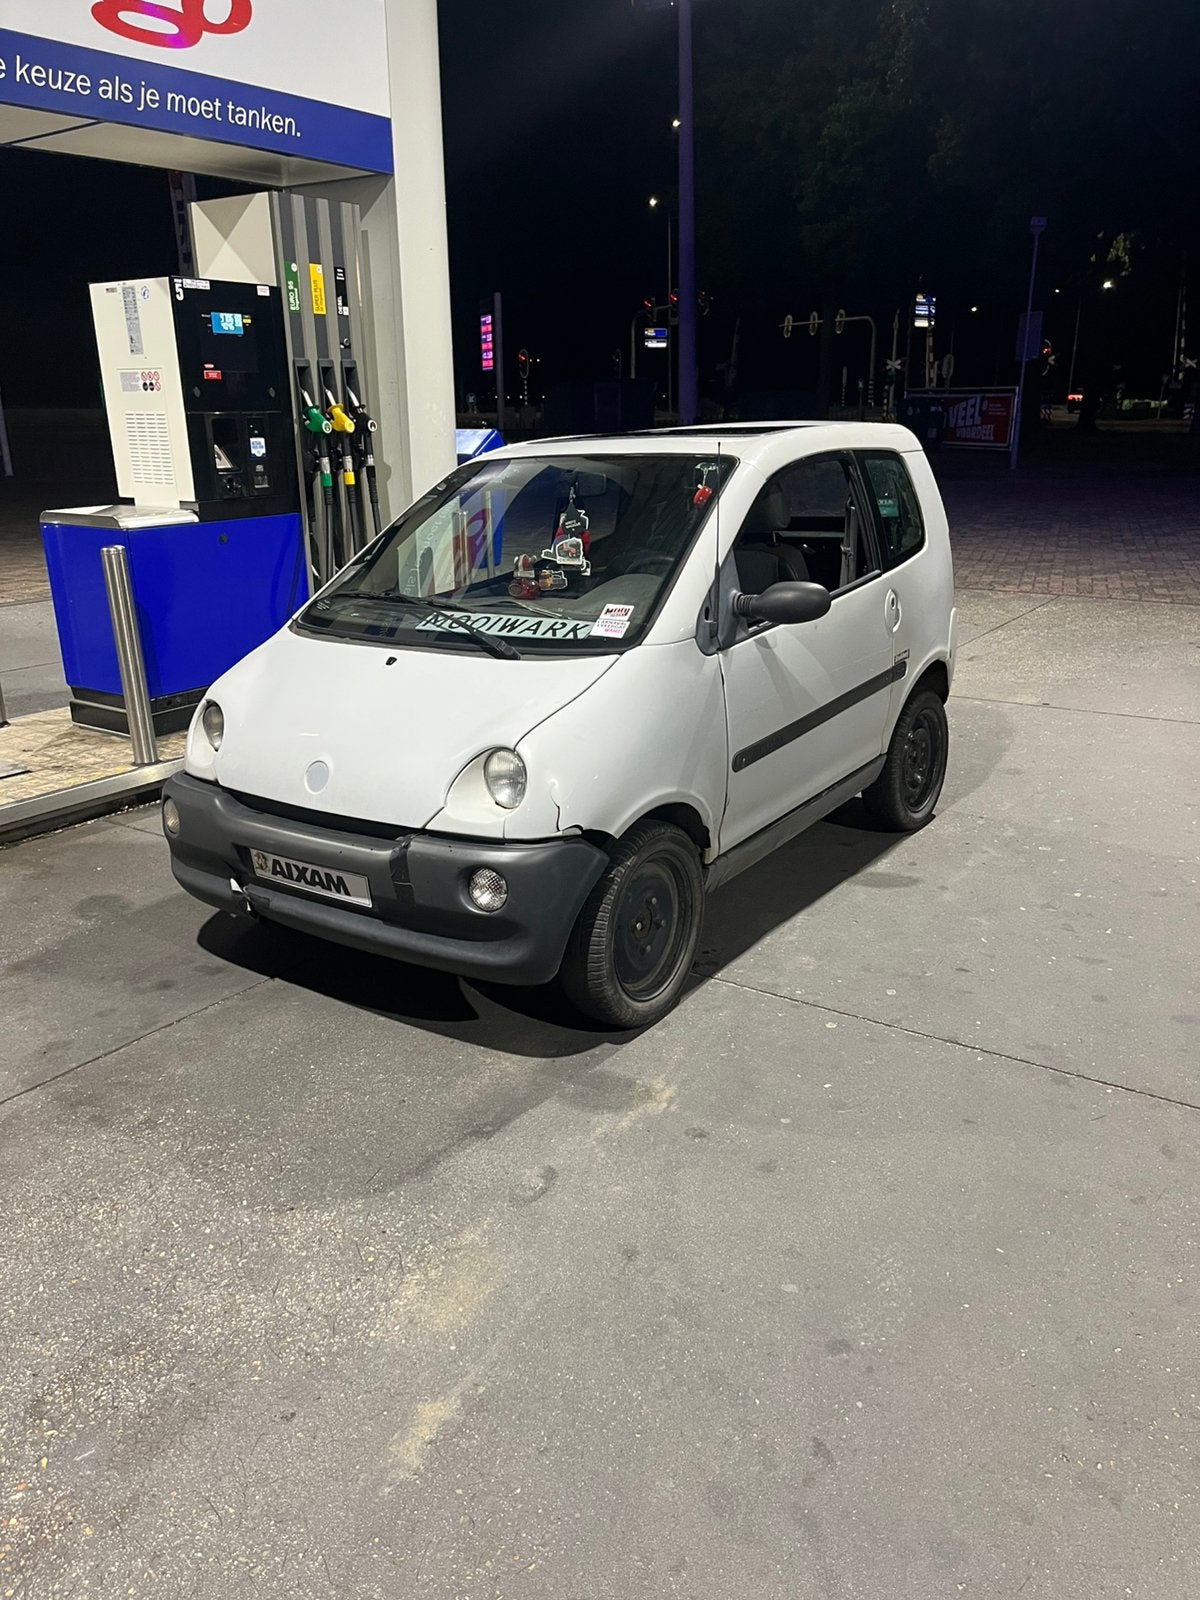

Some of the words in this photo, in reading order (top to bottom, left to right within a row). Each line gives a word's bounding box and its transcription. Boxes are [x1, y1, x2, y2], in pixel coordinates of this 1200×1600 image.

[15, 55, 91, 95] keuze
[98, 75, 133, 103] als
[136, 80, 160, 111] je
[166, 91, 222, 121] moet
[226, 100, 301, 137] tanken.
[174, 283, 185, 301] 5
[287, 280, 294, 290] 95
[949, 395, 982, 428] VEEL
[423, 613, 591, 640] MOOIWARK
[271, 858, 352, 897] AIXAM
